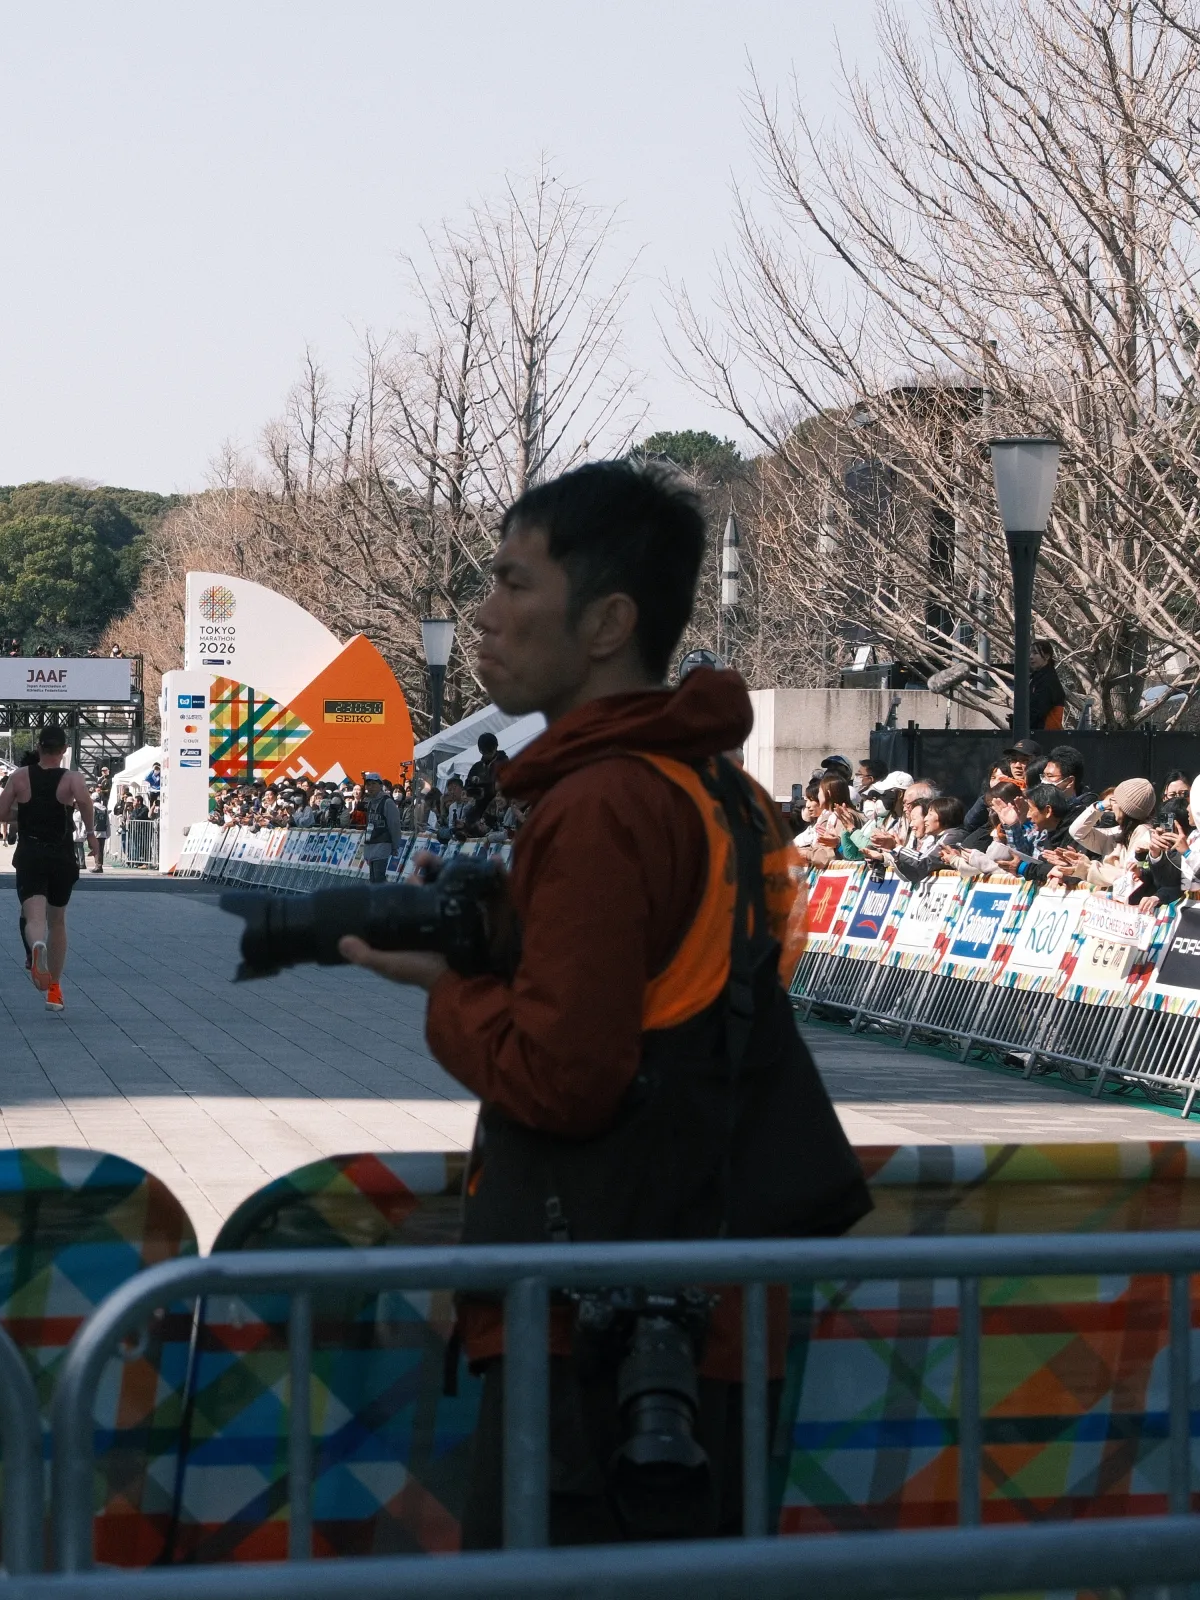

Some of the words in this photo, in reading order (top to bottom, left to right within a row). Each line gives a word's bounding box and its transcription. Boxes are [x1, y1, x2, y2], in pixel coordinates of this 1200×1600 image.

[200, 626, 236, 635] TOKYO
[199, 643, 236, 653] 2026
[26, 669, 68, 682] JAAF
[335, 702, 381, 713] 2:30:50
[335, 715, 372, 723] SEIKO
[859, 890, 890, 917] MIZUHO
